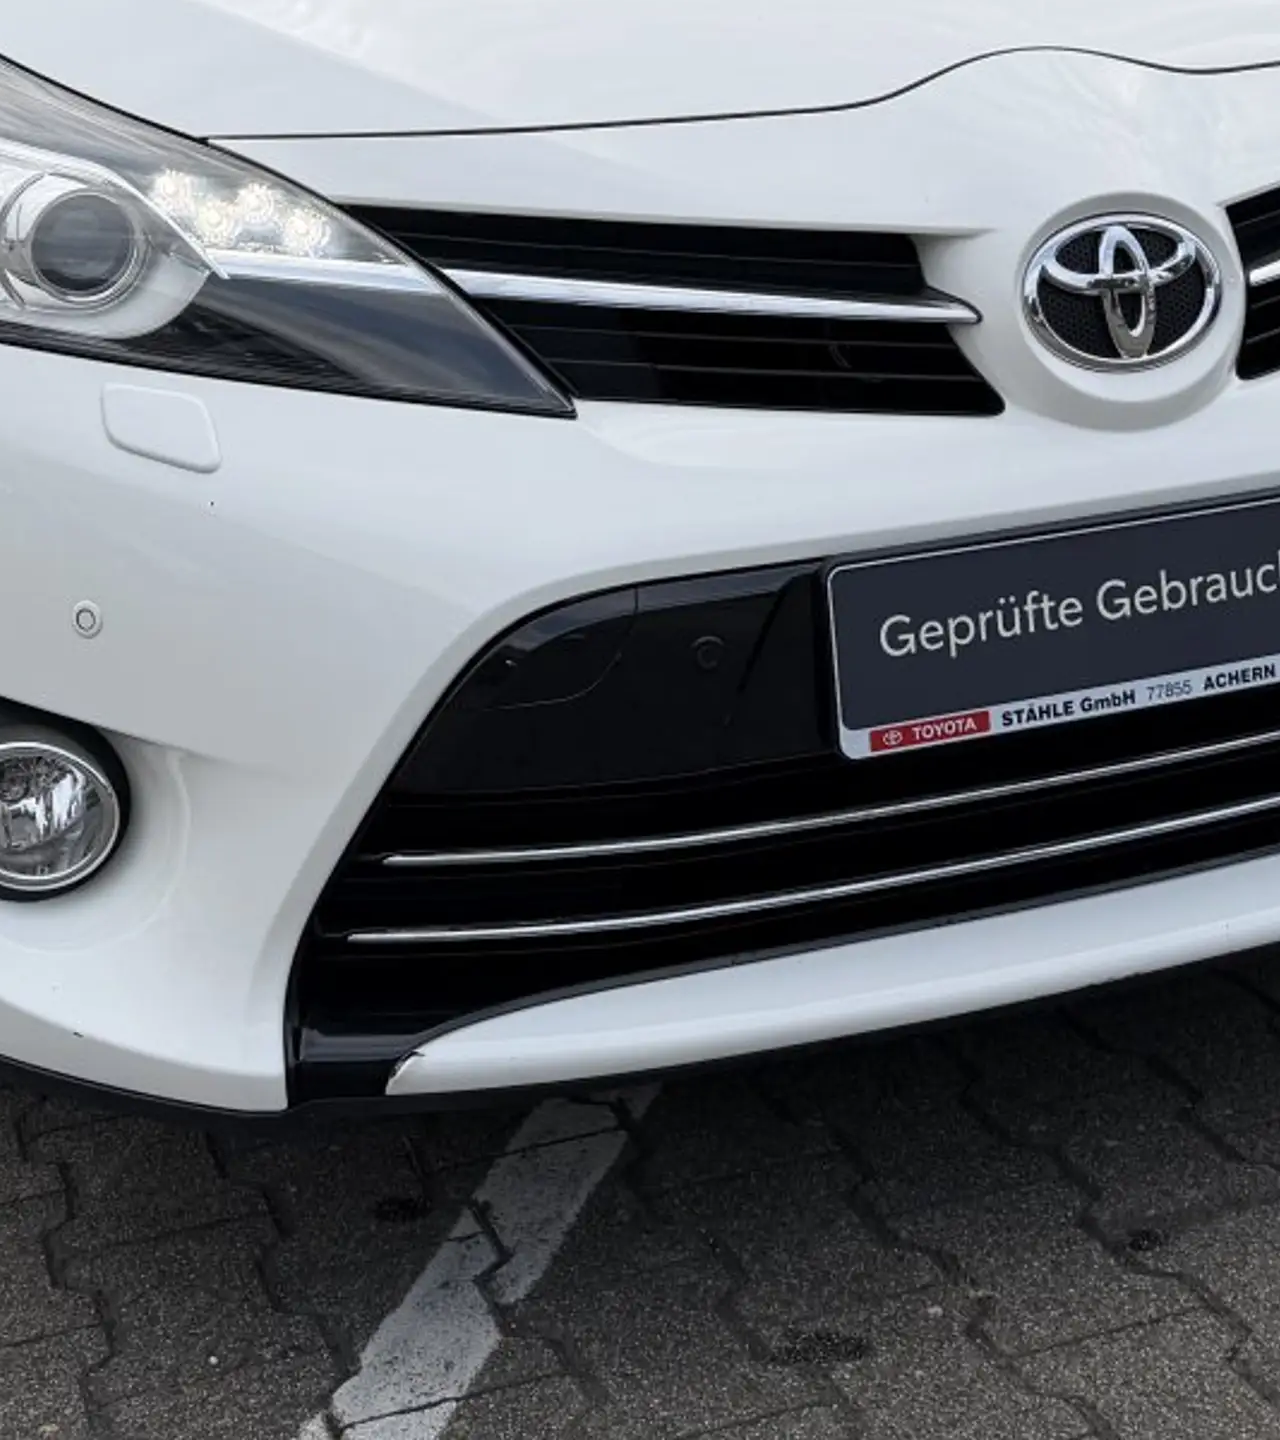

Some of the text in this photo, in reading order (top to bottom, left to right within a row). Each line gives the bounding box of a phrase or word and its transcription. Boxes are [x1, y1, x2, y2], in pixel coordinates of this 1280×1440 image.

[879, 590, 1084, 659] Geprüfte
[911, 717, 978, 742] TOYOTA
[1001, 700, 1074, 727] STÄHLE
[1080, 689, 1136, 713] GmbH
[1146, 679, 1193, 701] 77855
[1203, 664, 1277, 691] ACHERN
